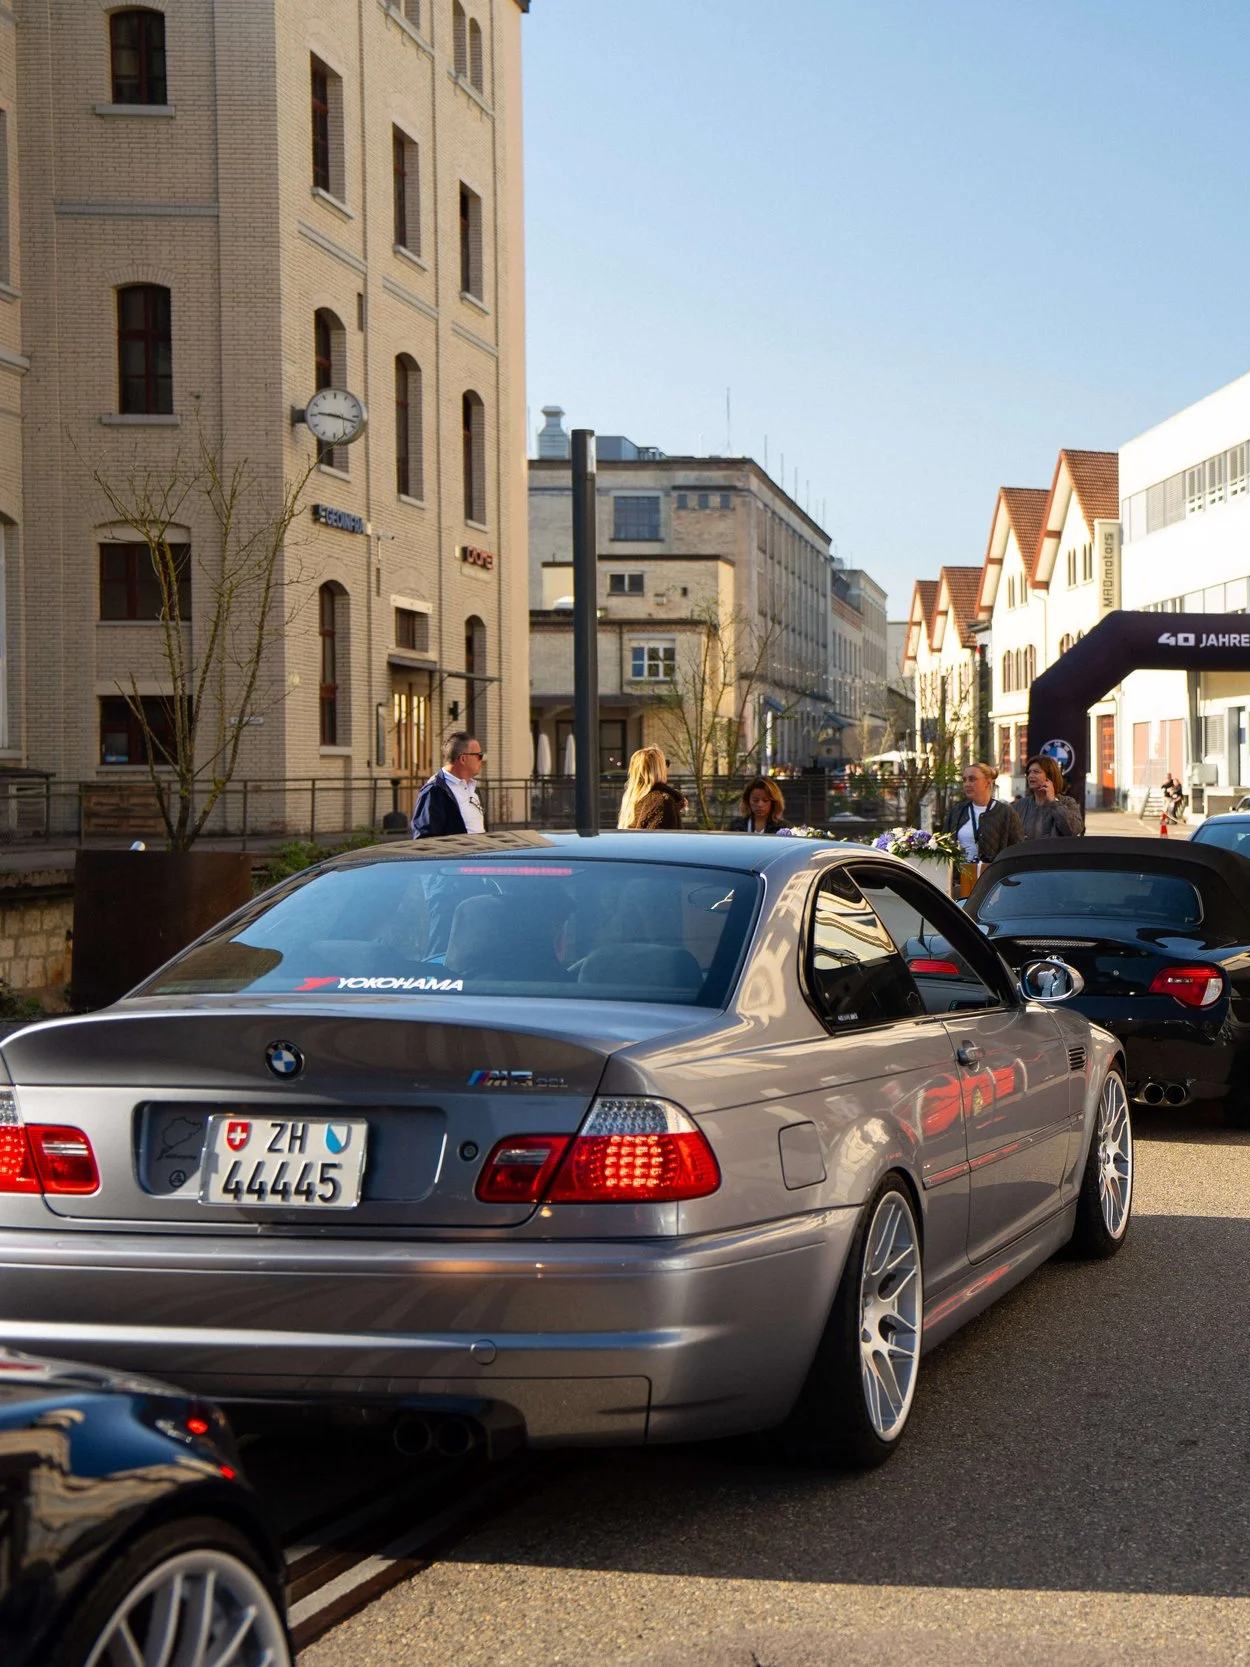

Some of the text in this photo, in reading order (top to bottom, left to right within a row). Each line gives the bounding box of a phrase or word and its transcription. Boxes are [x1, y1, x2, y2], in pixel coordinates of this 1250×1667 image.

[1158, 633, 1196, 646] 40
[1200, 633, 1250, 648] JAHRE
[337, 976, 464, 991] YOKOHAMA
[267, 1122, 308, 1154] ZH
[222, 1159, 343, 1203] 44445
